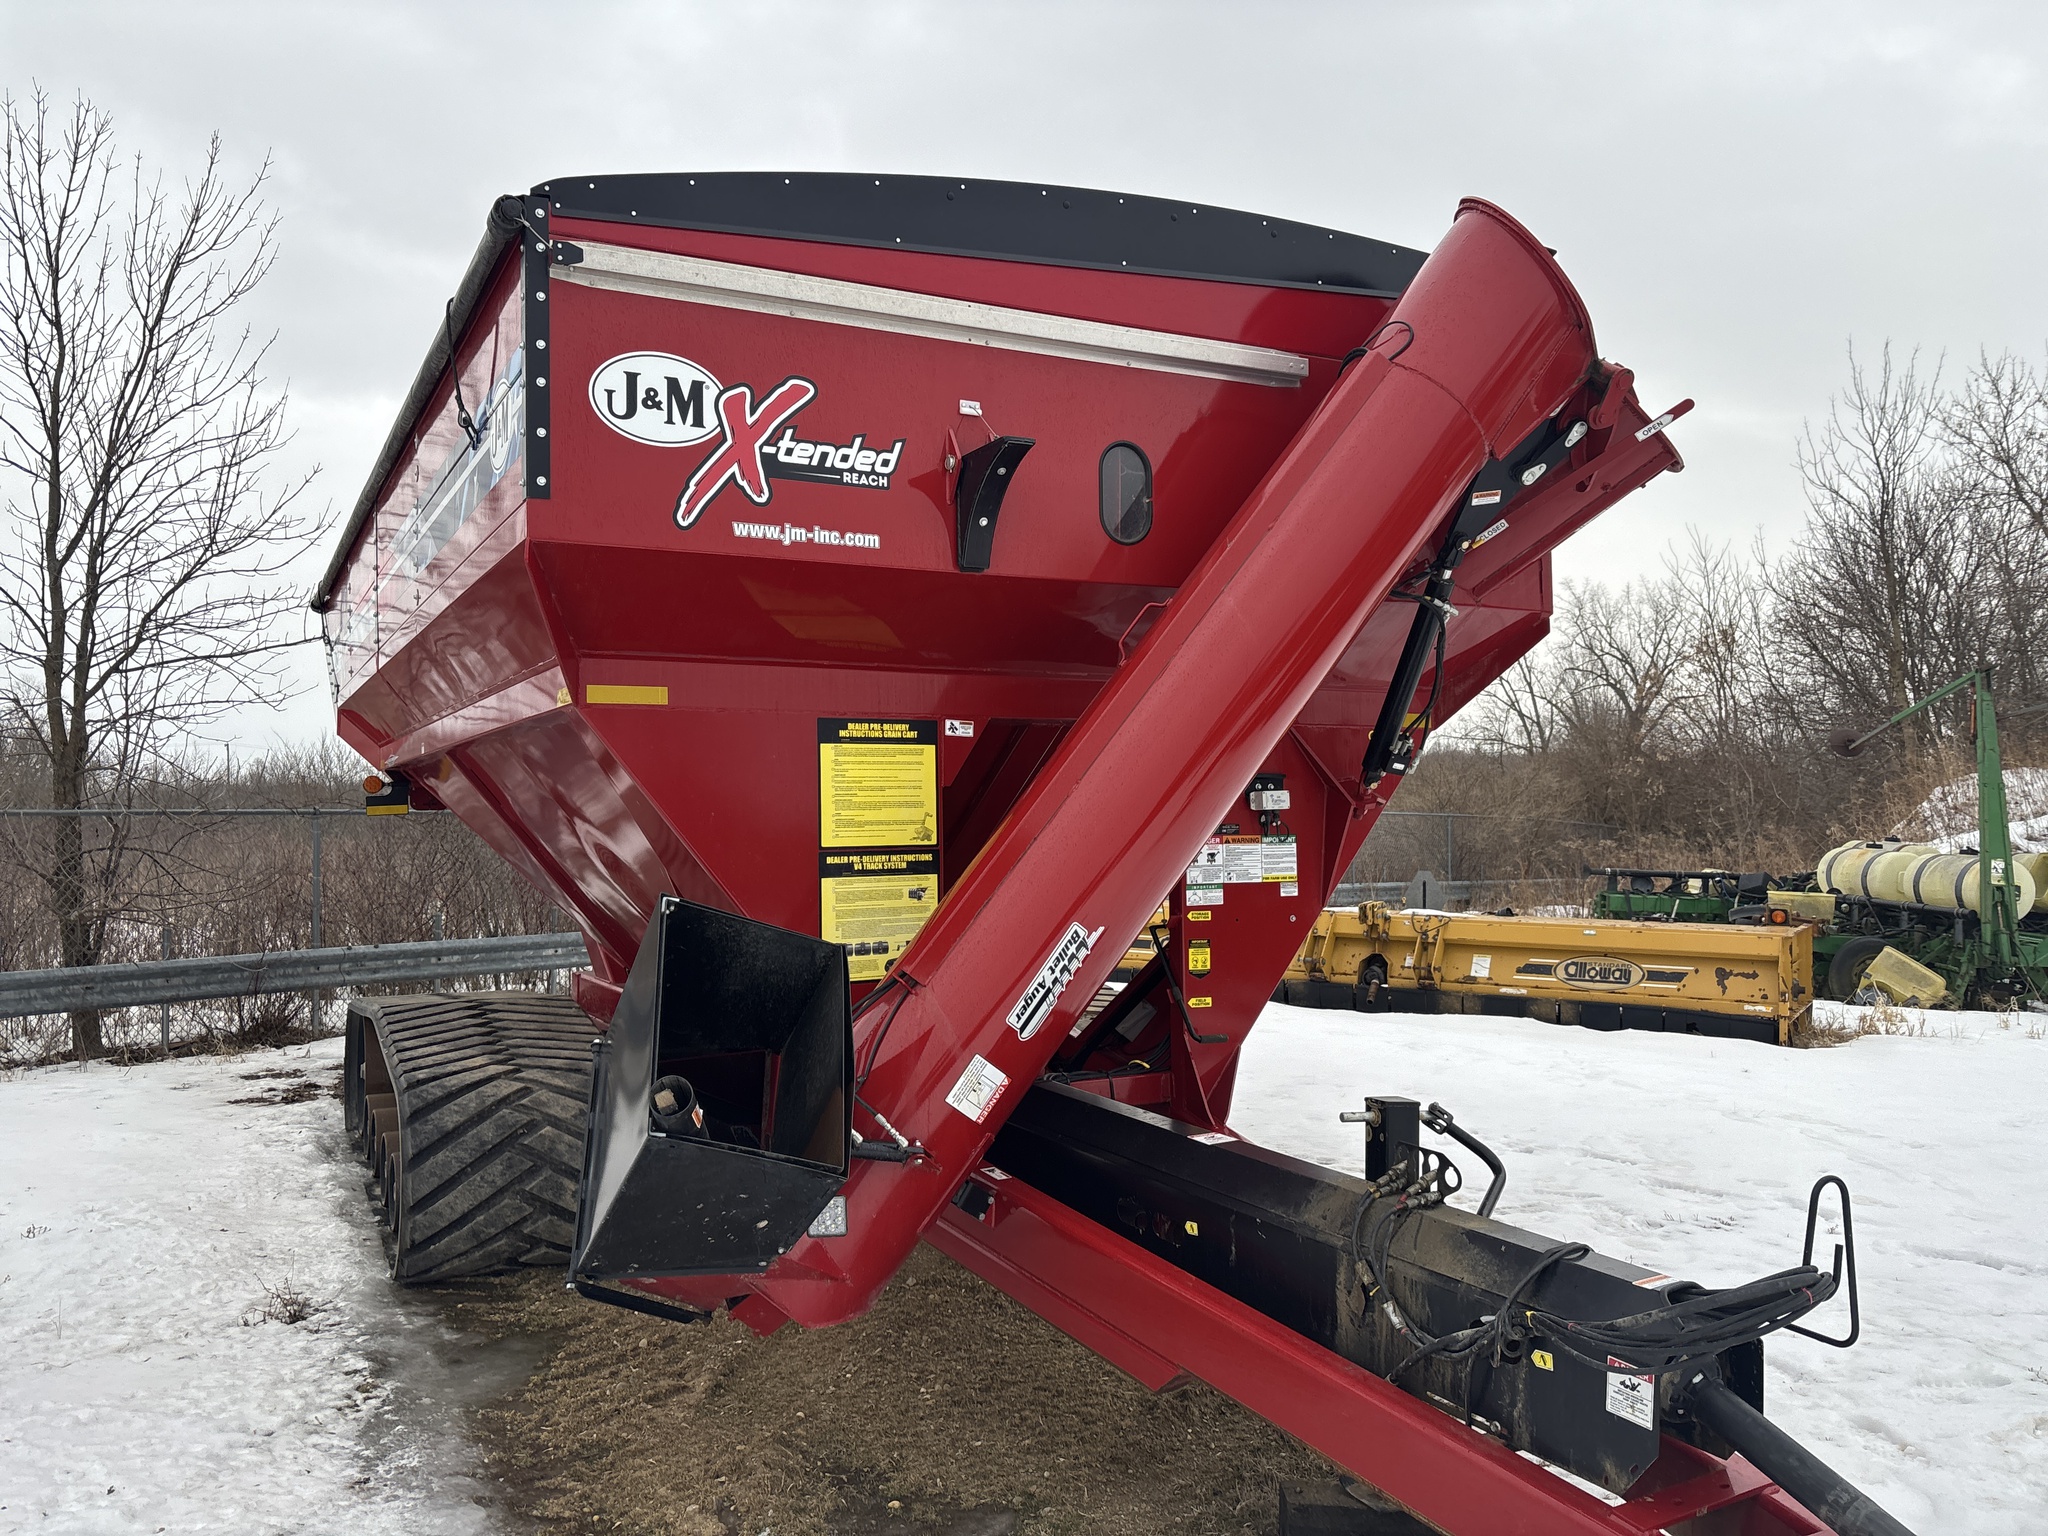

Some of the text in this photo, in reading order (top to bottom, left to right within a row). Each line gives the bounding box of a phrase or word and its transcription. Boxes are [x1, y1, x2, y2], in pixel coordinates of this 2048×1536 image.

[604, 370, 706, 429] J&M
[1641, 420, 1664, 437] OPEN
[842, 471, 888, 488] REACH
[732, 521, 881, 549] www.jm-inc.com
[838, 729, 918, 739] INSTRUCTIONS GRAIN CART
[847, 722, 909, 731] DEALER PRE-DELIVERY
[826, 853, 933, 864] DEALER PRE-DELIVERY INSTRUCTIONS
[853, 860, 907, 871] V4 TRACK SYSTEM
[1015, 928, 1081, 1024] Bullet Auger
[976, 1087, 1004, 1124] DANGER
